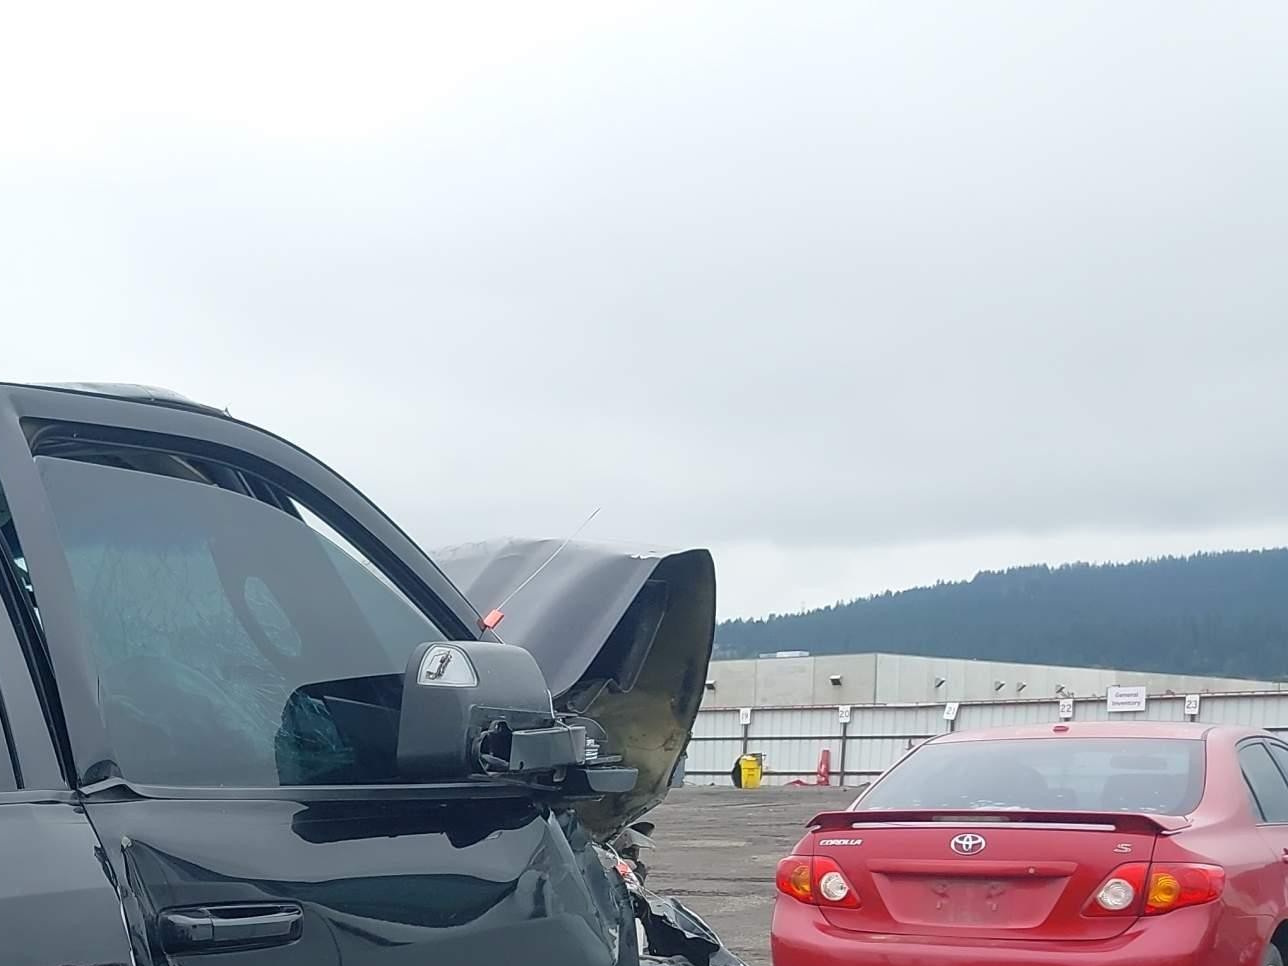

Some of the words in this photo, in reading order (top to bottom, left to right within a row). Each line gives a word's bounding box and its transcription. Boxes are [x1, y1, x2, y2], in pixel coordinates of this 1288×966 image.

[1061, 704, 1071, 712] 22
[1186, 701, 1197, 709] 23
[839, 710, 849, 718] 20
[1112, 843, 1132, 853] S
